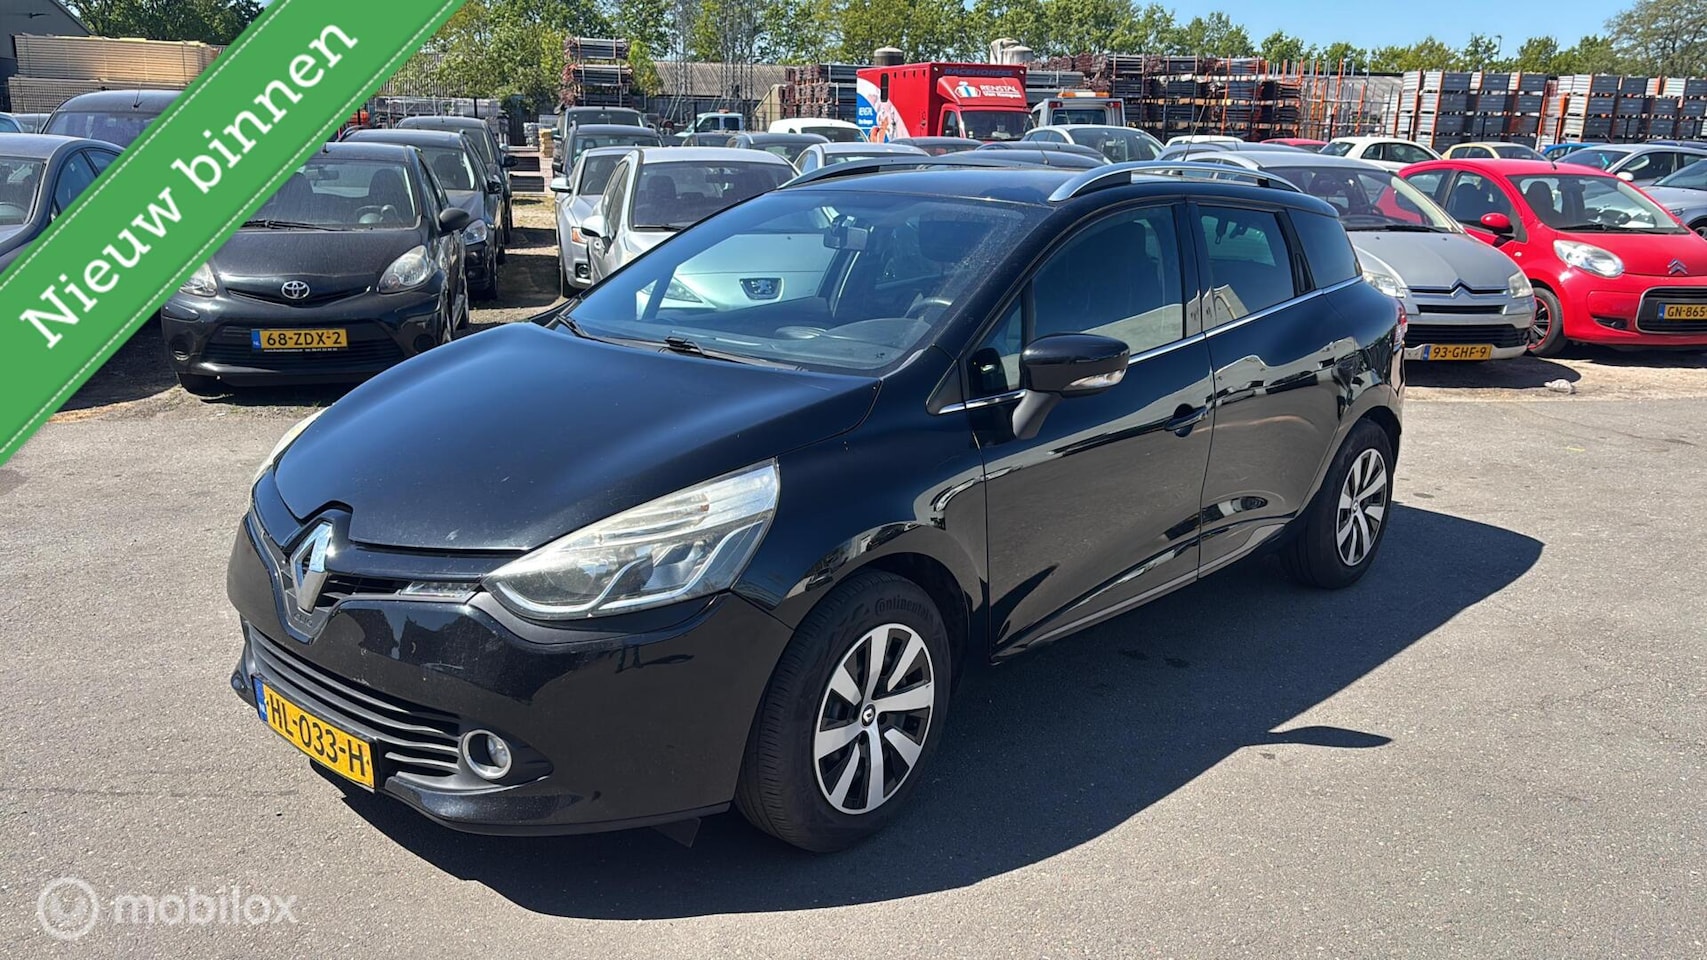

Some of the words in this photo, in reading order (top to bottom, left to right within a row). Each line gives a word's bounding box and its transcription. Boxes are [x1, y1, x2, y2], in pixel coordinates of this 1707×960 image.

[266, 332, 342, 346] 68-ZDX-2
[1433, 346, 1487, 359] 93-GHF-9
[268, 693, 366, 777] HL-033-H
